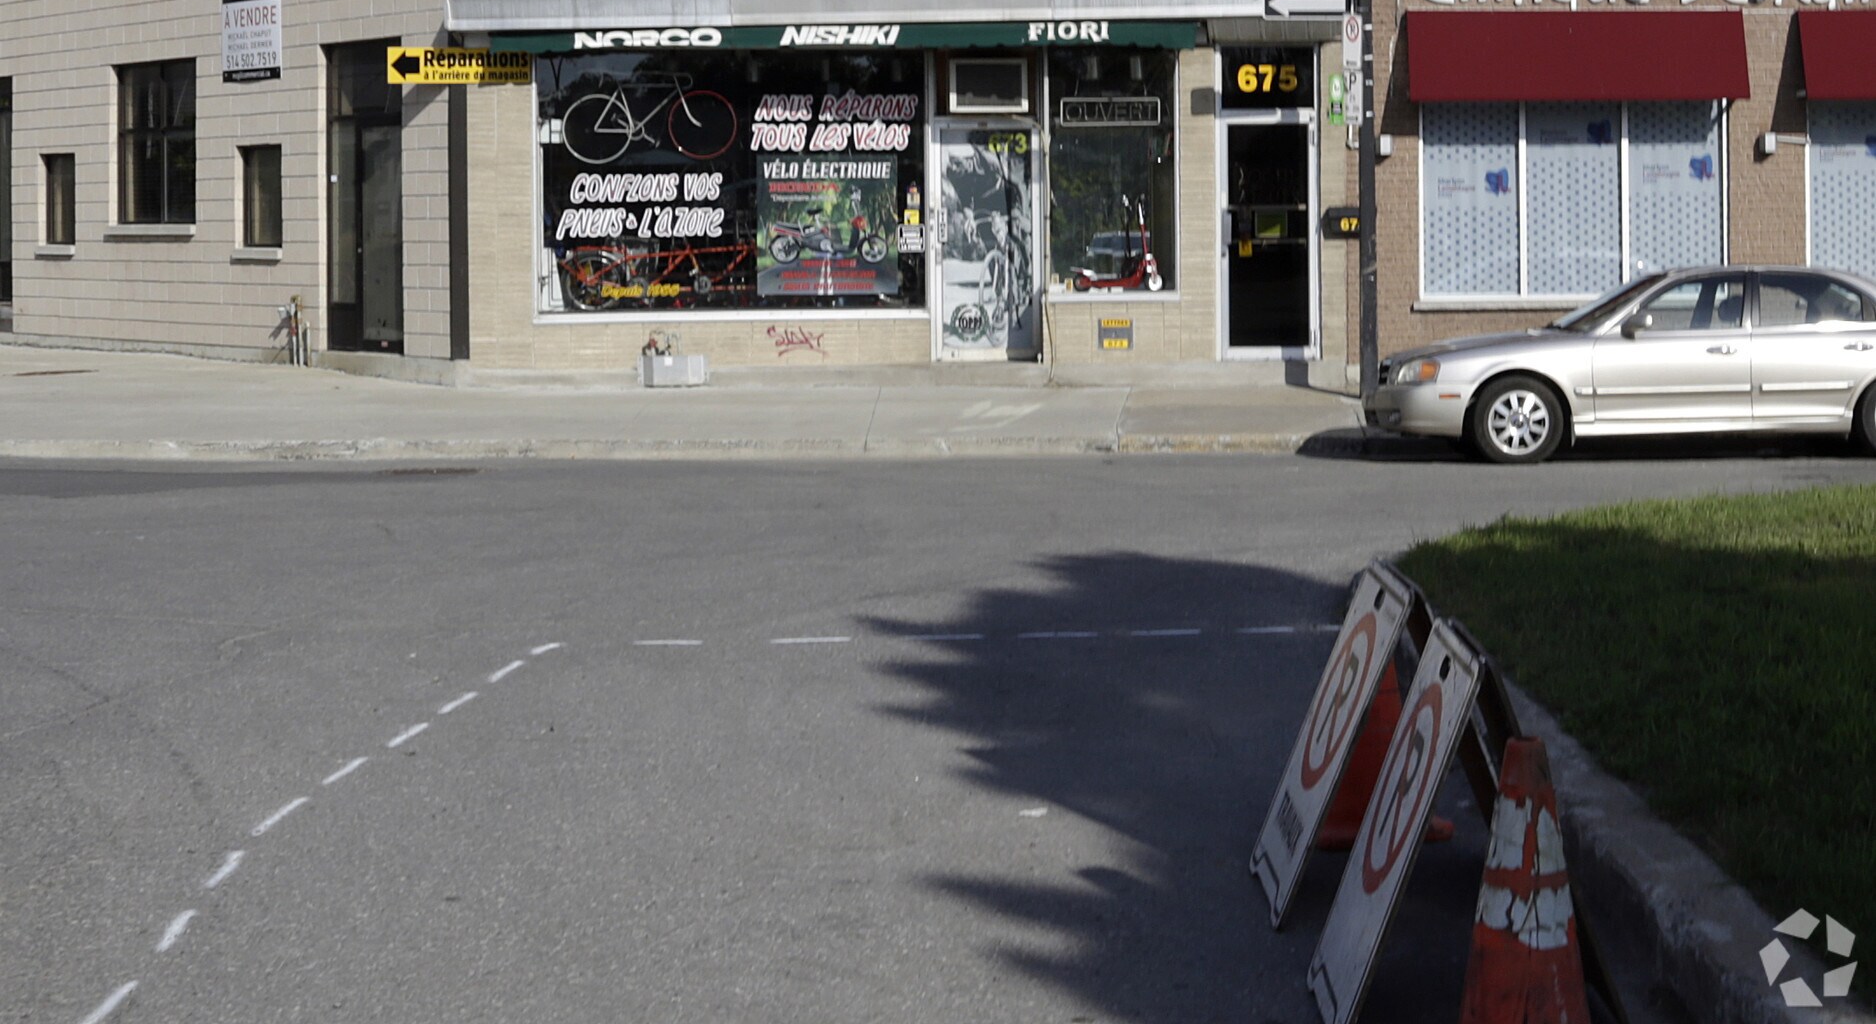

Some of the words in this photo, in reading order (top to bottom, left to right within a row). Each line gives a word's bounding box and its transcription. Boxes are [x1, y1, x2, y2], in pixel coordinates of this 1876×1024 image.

[224, 5, 231, 29] À
[233, 5, 277, 28] VENDRE
[574, 28, 722, 49] NORCO
[779, 25, 900, 46] NISHIKI
[1028, 21, 1109, 42] FIORI
[424, 48, 528, 69] Réparations
[424, 69, 429, 80] à
[432, 69, 470, 80] l'arrière
[474, 69, 485, 80] du
[488, 70, 528, 82] magasin
[1237, 64, 1297, 93] 675
[754, 94, 813, 121] NOUS
[1065, 103, 1156, 121] OUVERT
[751, 122, 807, 151] TOUS
[988, 133, 1027, 154] 673
[763, 158, 799, 179] VÉLO
[802, 158, 891, 179] ÉLECTRIQUE
[683, 172, 723, 201] VOS
[1341, 217, 1359, 231] 67
